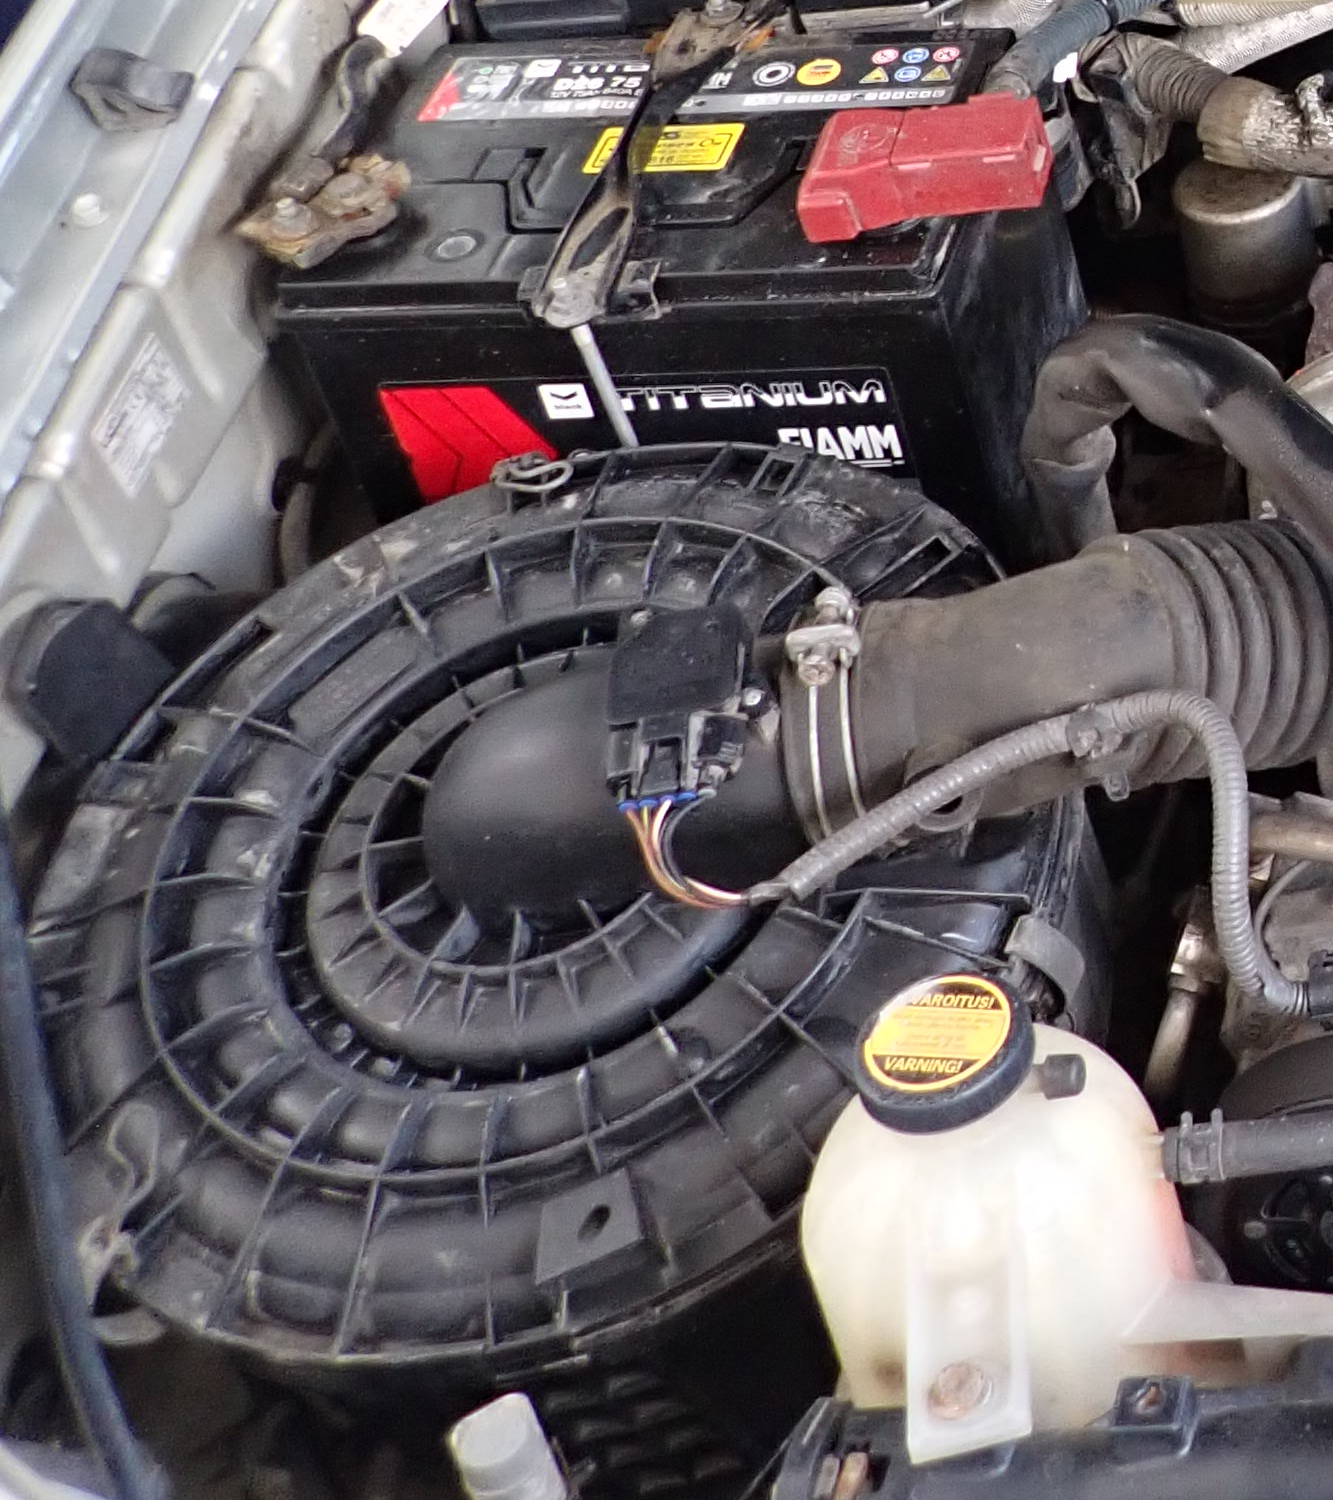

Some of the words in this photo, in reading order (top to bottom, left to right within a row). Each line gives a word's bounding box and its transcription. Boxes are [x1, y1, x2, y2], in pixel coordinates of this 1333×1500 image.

[610, 76, 643, 89] 75
[911, 992, 995, 1008] VAROITUS!
[883, 1056, 964, 1074] VARNING!
